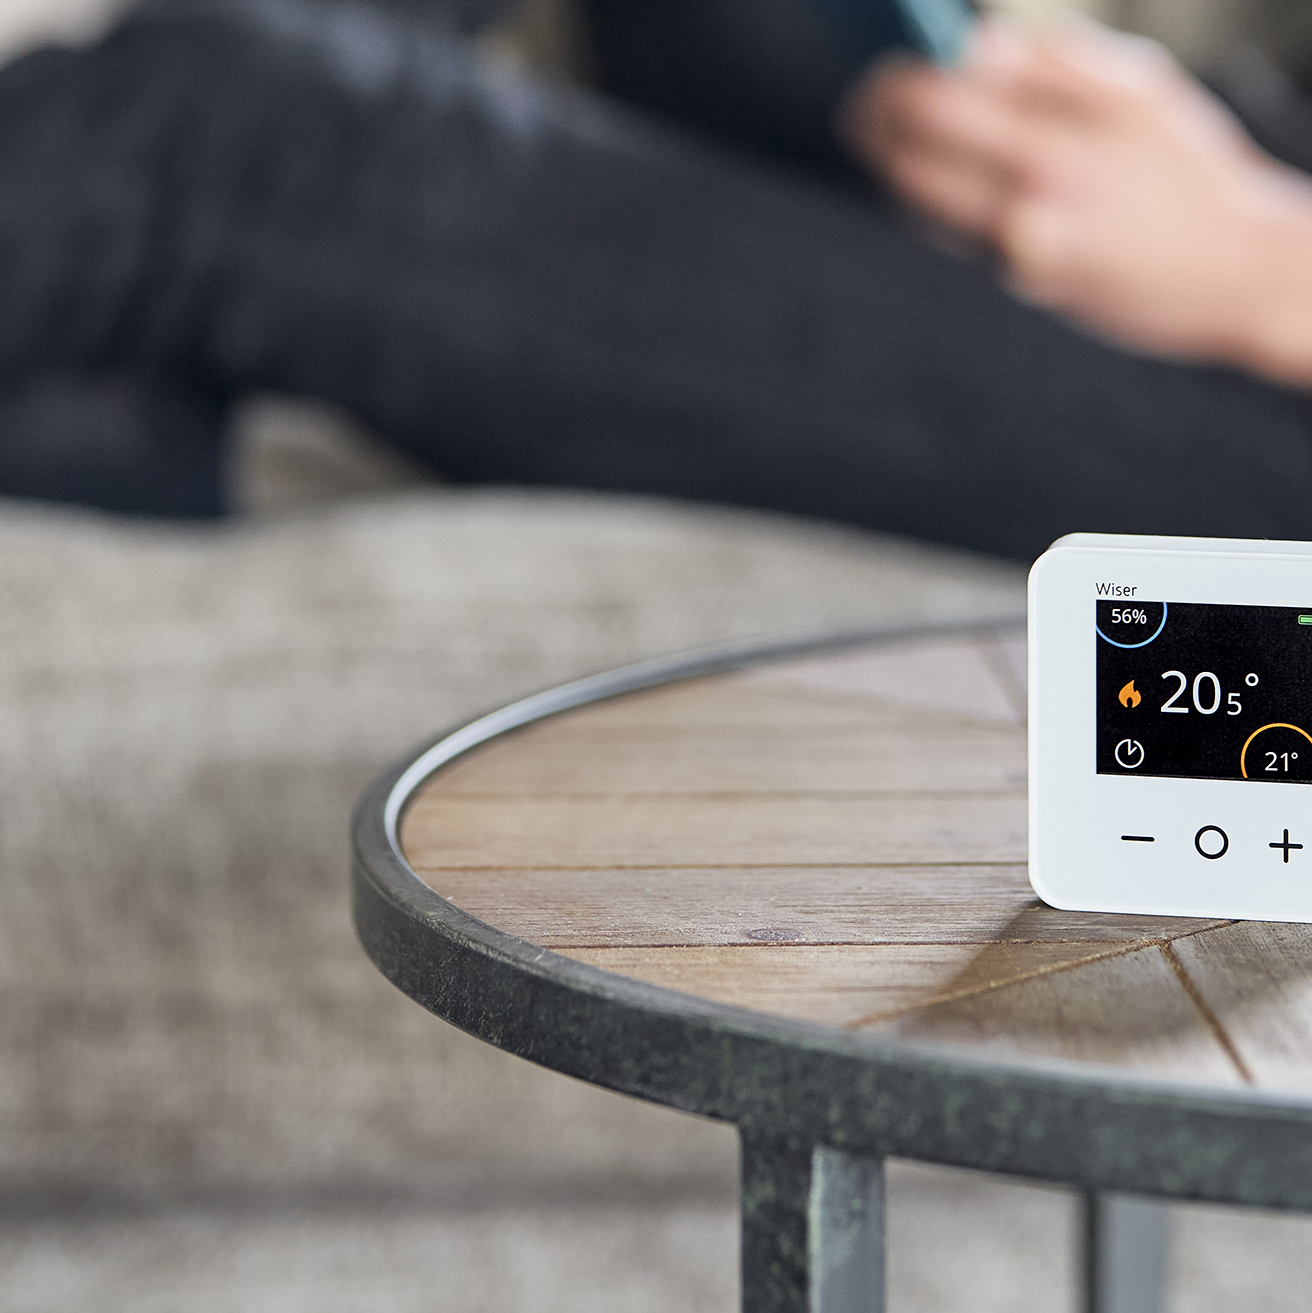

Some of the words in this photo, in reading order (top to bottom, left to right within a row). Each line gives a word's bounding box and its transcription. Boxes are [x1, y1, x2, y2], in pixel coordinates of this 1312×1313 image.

[1095, 582, 1137, 597] Wiser
[1111, 608, 1147, 624] 56%
[1264, 752, 1299, 773] 21°
